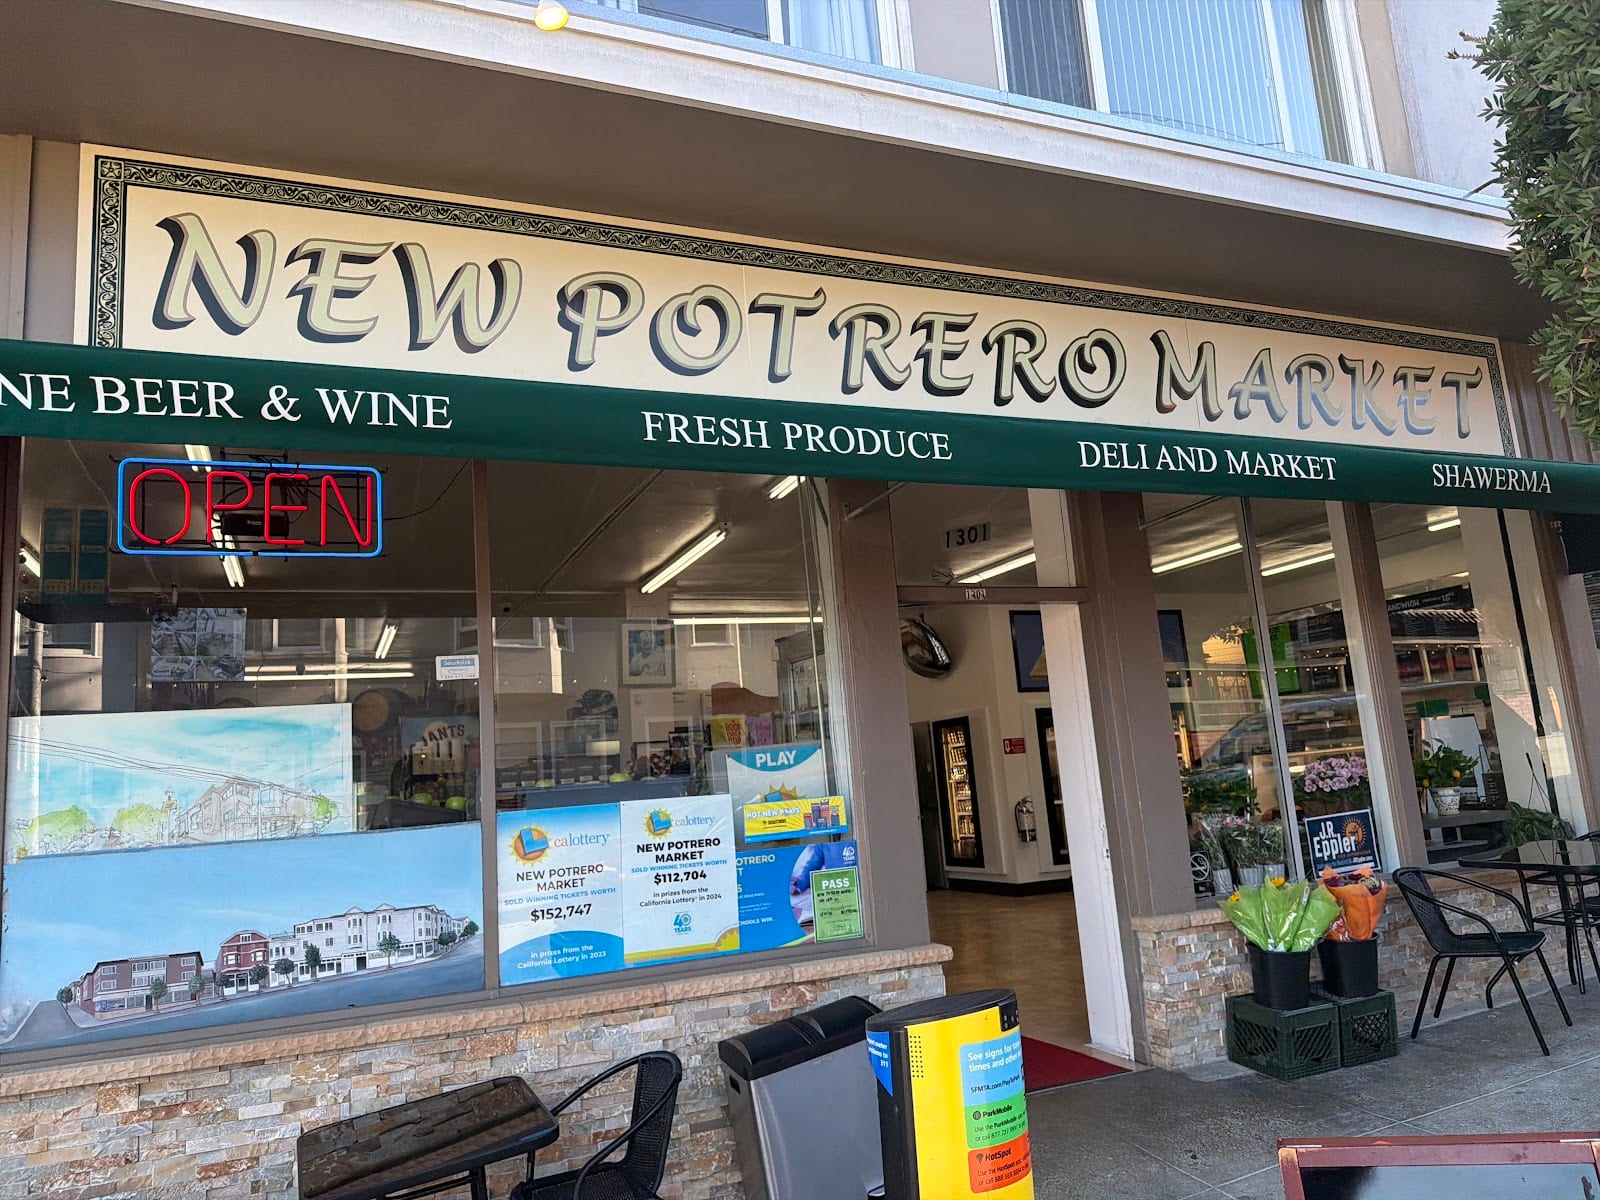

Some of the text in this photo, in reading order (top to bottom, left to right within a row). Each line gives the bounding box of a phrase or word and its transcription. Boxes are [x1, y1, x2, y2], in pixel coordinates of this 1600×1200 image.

[153, 212, 1482, 439] NEW POTRERO MARKET
[90, 376, 244, 419] BEER
[261, 385, 302, 422] &
[314, 387, 453, 429] WINE
[641, 411, 953, 460] FRESH PRODUCE
[1078, 441, 1337, 481] DELI AND MARKET
[1432, 463, 1552, 494] SHAWERMA
[129, 468, 372, 546] OPEN
[945, 523, 987, 549] 1301
[1387, 600, 1420, 611] ANDWICH
[421, 724, 465, 746] IANTS
[755, 750, 797, 767] PLAY
[674, 815, 714, 826] calottery
[1320, 820, 1337, 840] J.R.
[553, 833, 609, 848] calottery
[636, 838, 720, 853] NEW POTRERO
[1313, 833, 1356, 861] Eppler
[655, 850, 704, 863] MARKET
[736, 854, 776, 866] OTRERO
[516, 863, 604, 882] NEW POTRERO
[654, 870, 707, 885] $112,704
[536, 877, 586, 892] MARKET
[821, 878, 850, 890] PASS
[525, 894, 559, 904] WINNING
[560, 890, 588, 899] TICKETS
[590, 887, 616, 895] WORTH
[661, 889, 680, 898] prizes
[530, 903, 592, 923] $152,747
[517, 959, 552, 969] California
[553, 954, 580, 965] Lottery
[540, 949, 561, 959] prizes
[967, 1052, 983, 1062] See
[985, 1048, 1003, 1060] signs
[880, 1059, 889, 1068] 311
[968, 1062, 991, 1073] times
[991, 1056, 1005, 1068] and
[982, 1104, 1012, 1118] ParkMobile
[985, 1147, 1012, 1161] HotSpot
